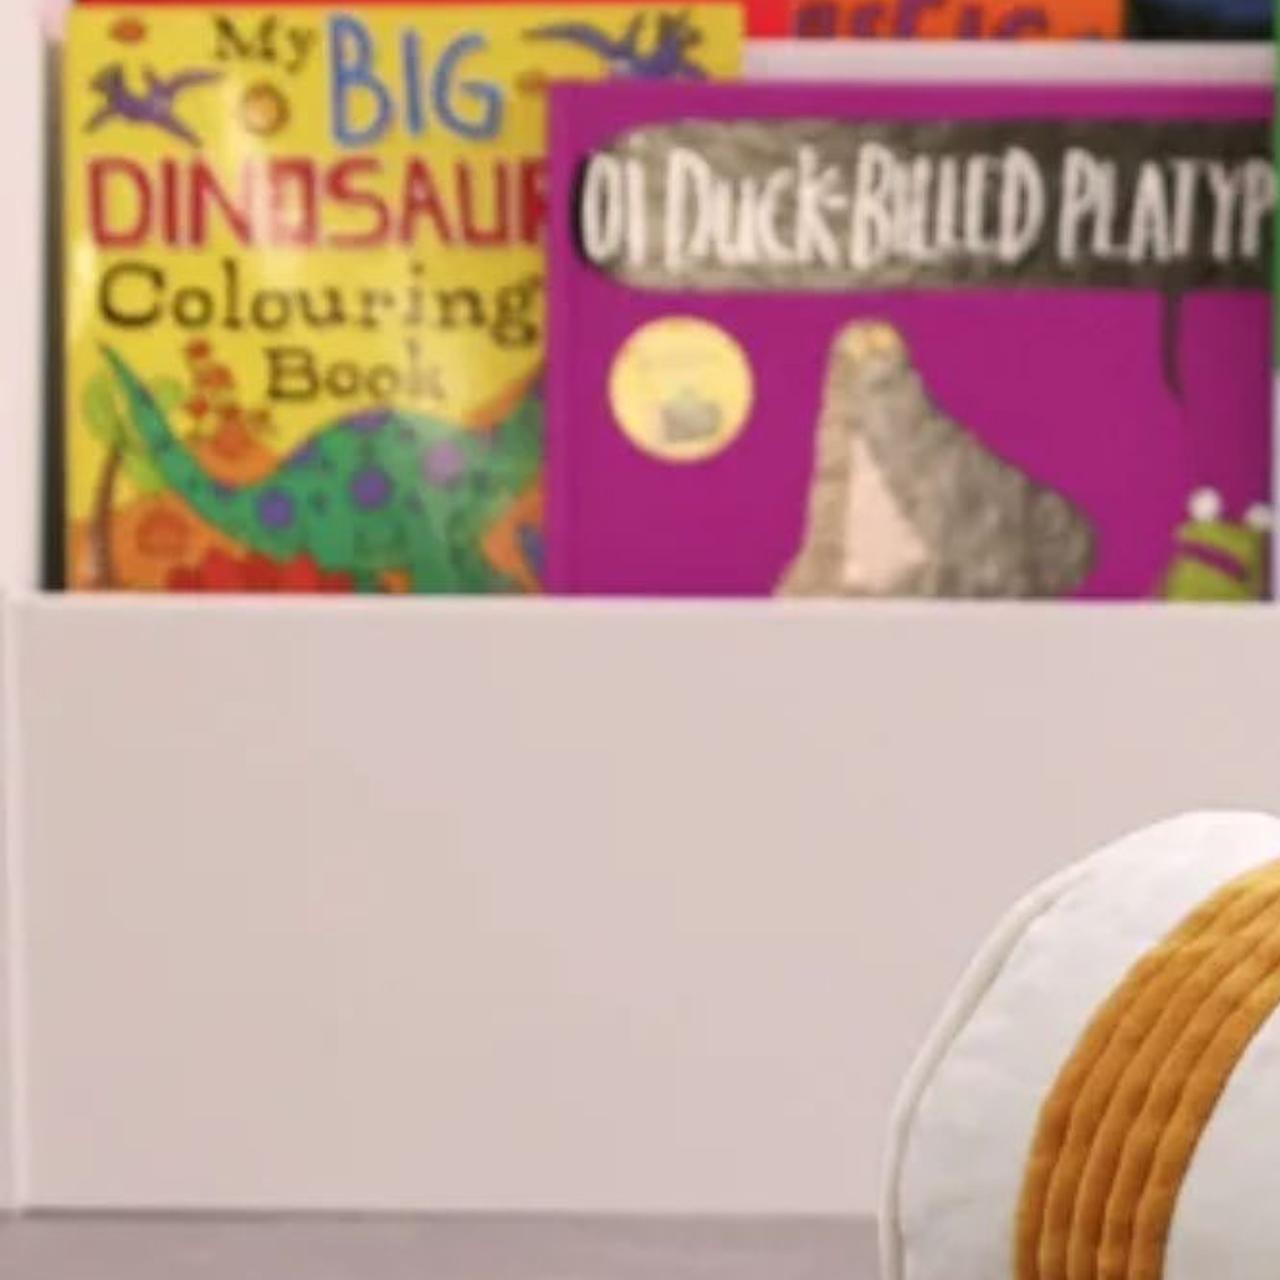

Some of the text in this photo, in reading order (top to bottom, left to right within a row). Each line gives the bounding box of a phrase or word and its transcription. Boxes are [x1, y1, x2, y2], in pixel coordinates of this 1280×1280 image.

[213, 13, 504, 147] My BIG
[99, 260, 538, 348] Colouring
[265, 345, 446, 402] Book
